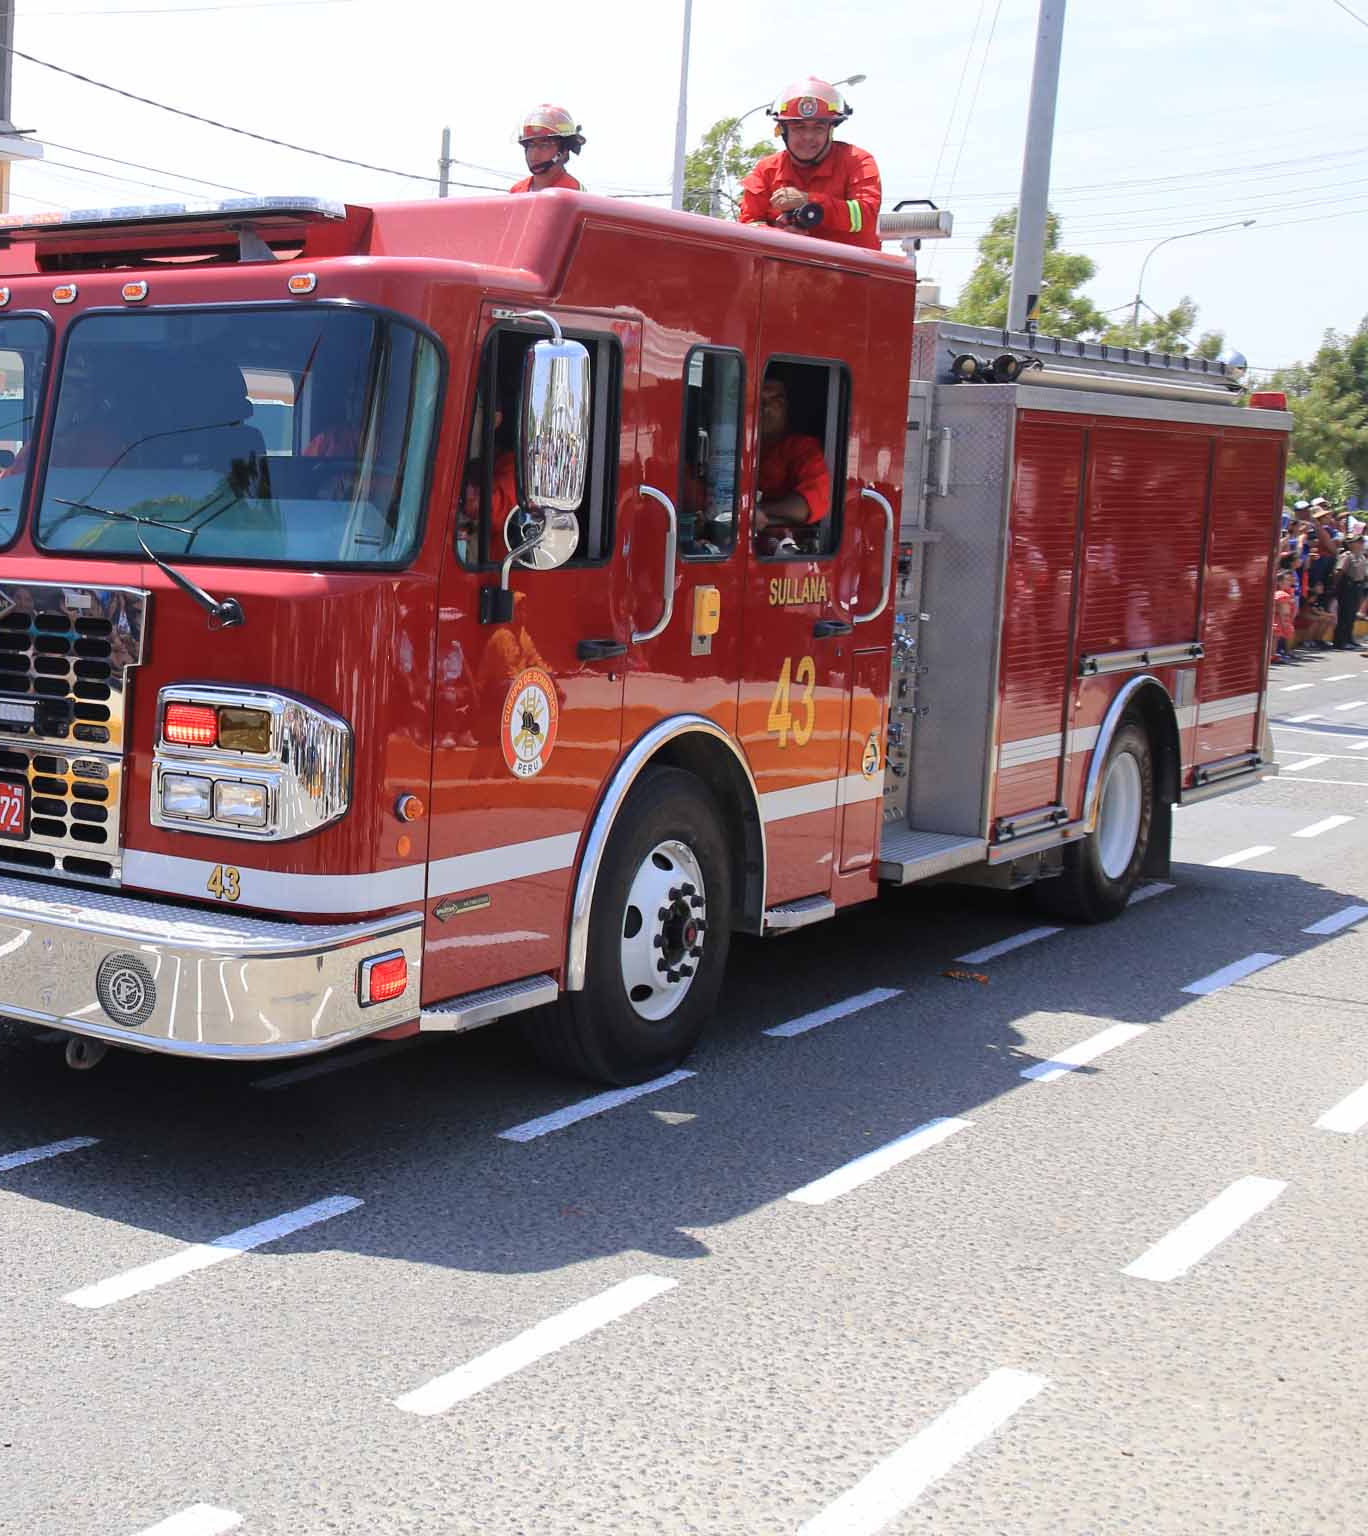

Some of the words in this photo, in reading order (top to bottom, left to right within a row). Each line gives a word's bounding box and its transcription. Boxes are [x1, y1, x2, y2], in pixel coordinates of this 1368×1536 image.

[769, 576, 828, 605] SULLANA
[768, 656, 816, 748] 43
[207, 864, 240, 902] 43
